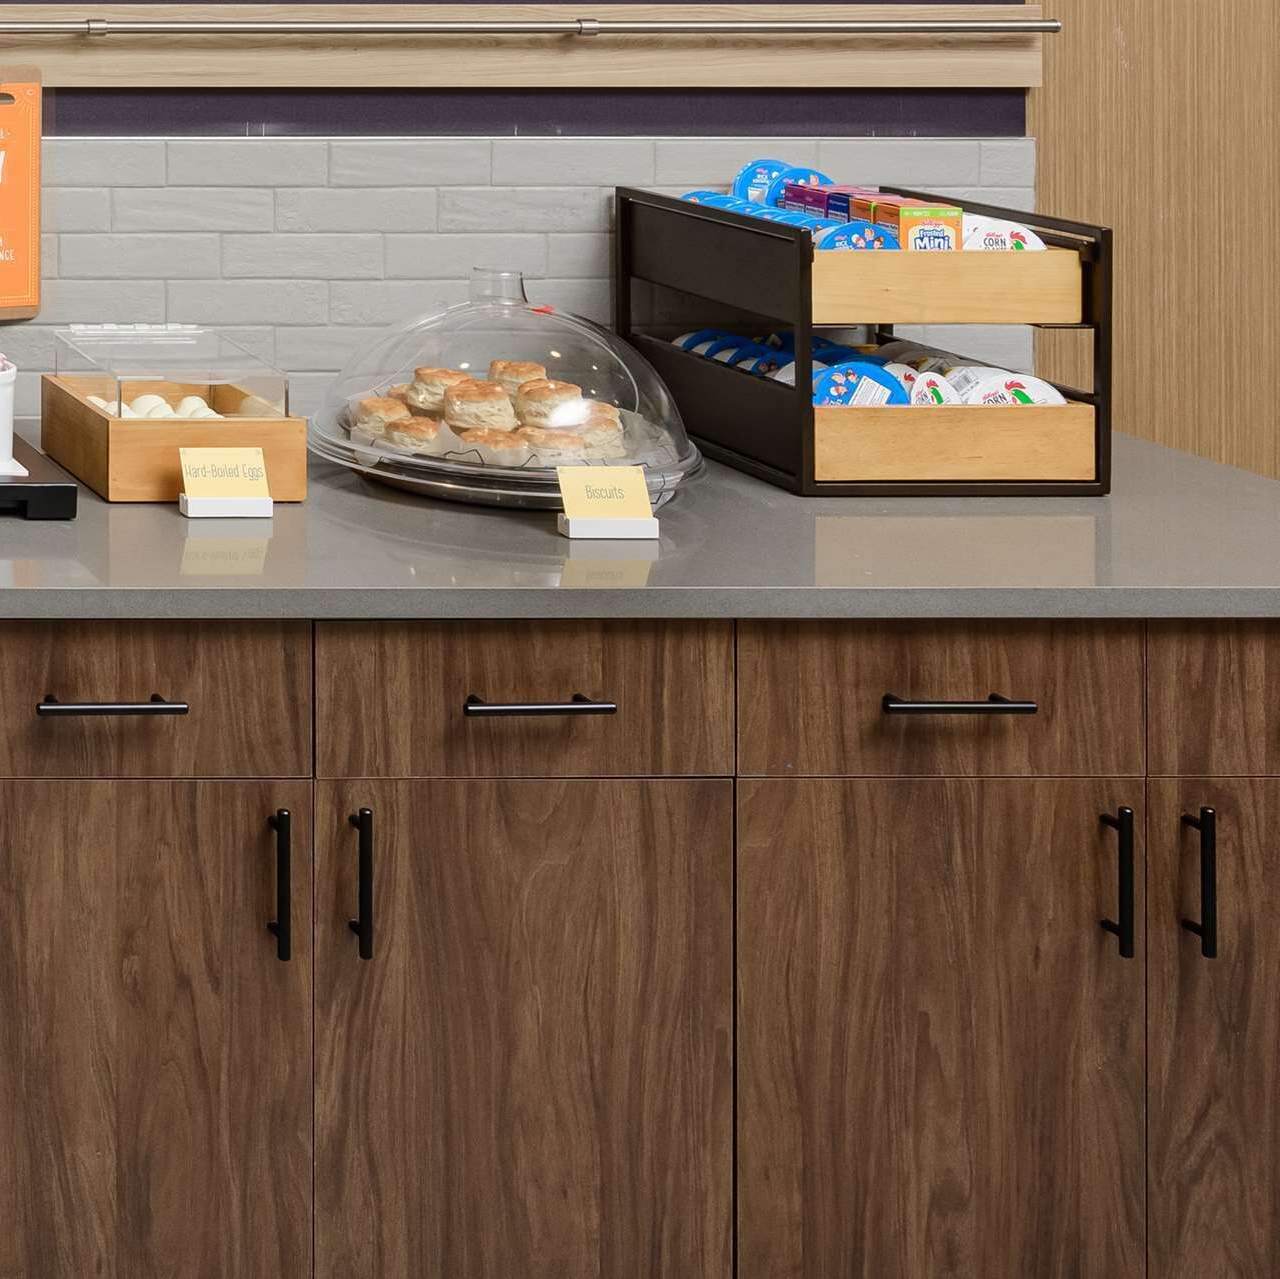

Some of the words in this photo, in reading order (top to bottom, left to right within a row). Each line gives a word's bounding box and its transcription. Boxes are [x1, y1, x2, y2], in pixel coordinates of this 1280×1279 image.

[983, 237, 1007, 248] CORN
[184, 464, 240, 478] Hard-Boiled
[242, 464, 264, 481] Eggs
[584, 484, 625, 500] Biscuits
